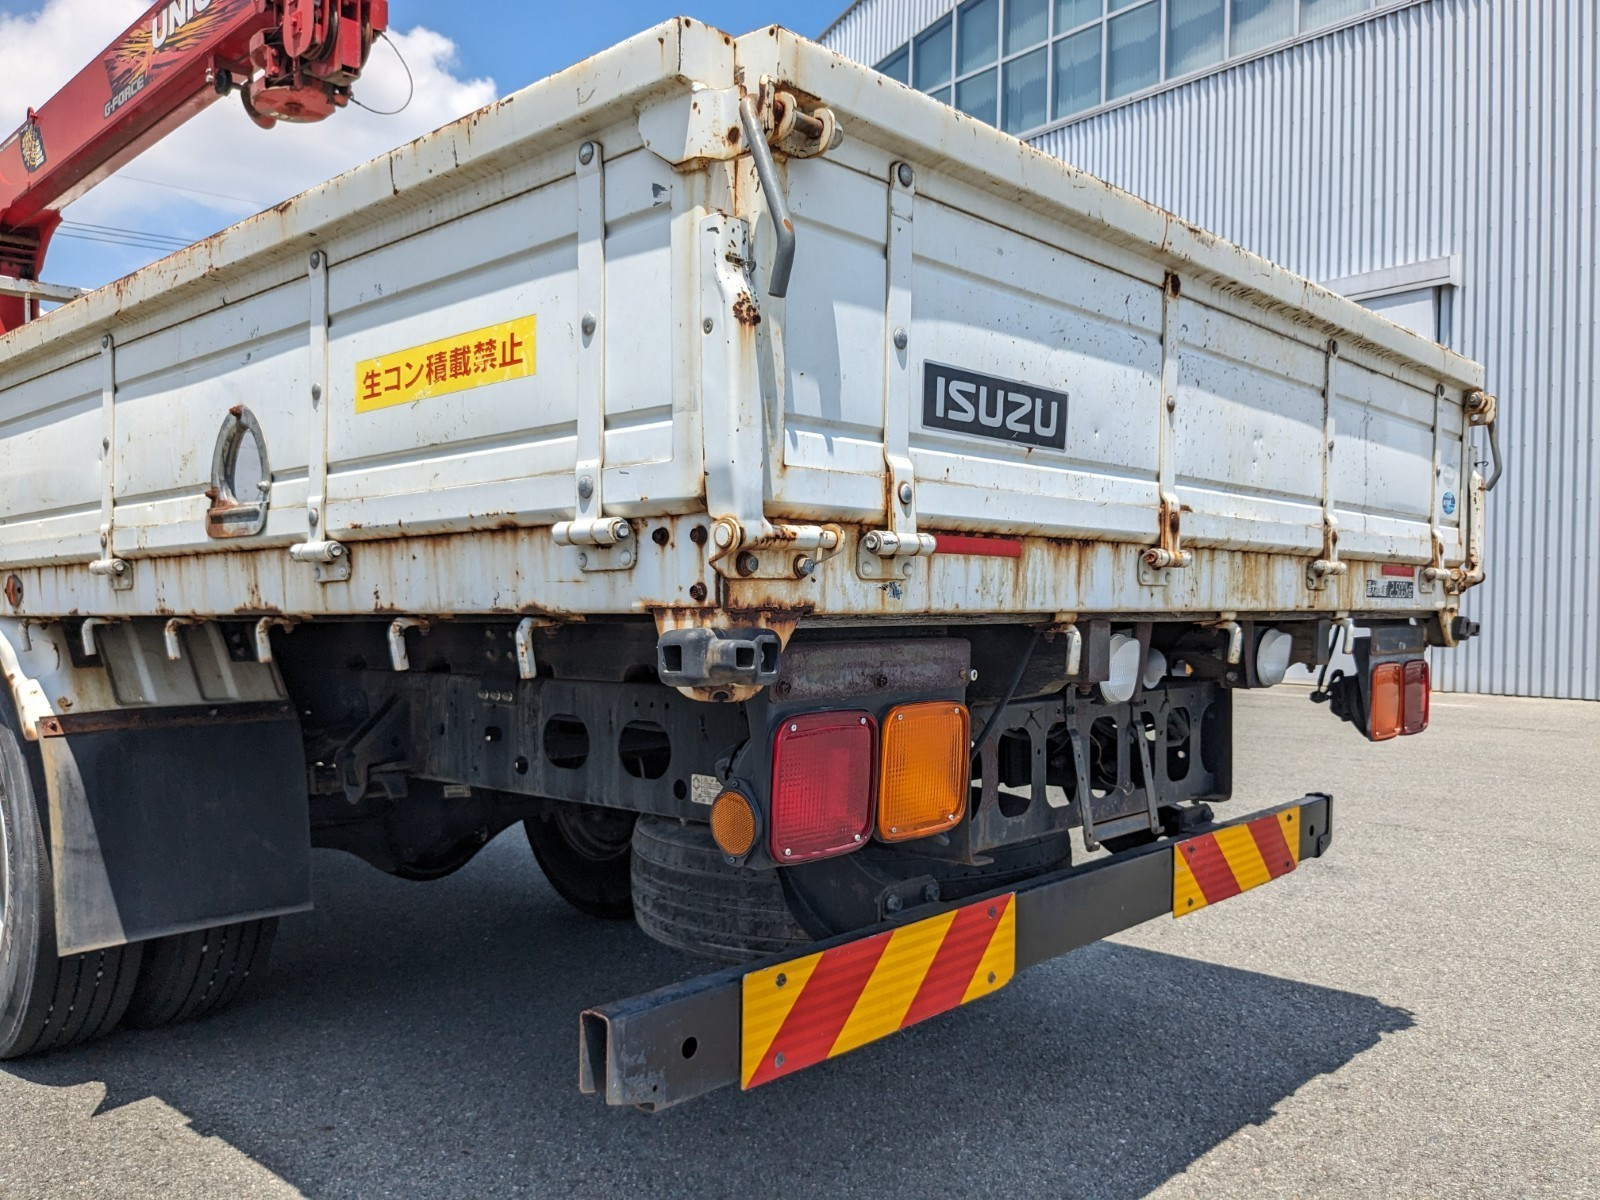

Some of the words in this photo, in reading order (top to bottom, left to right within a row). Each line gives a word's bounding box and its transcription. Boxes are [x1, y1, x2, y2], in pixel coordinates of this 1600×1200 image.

[362, 332, 524, 401] 生コン積載禁止
[935, 376, 1058, 438] ISUZU
